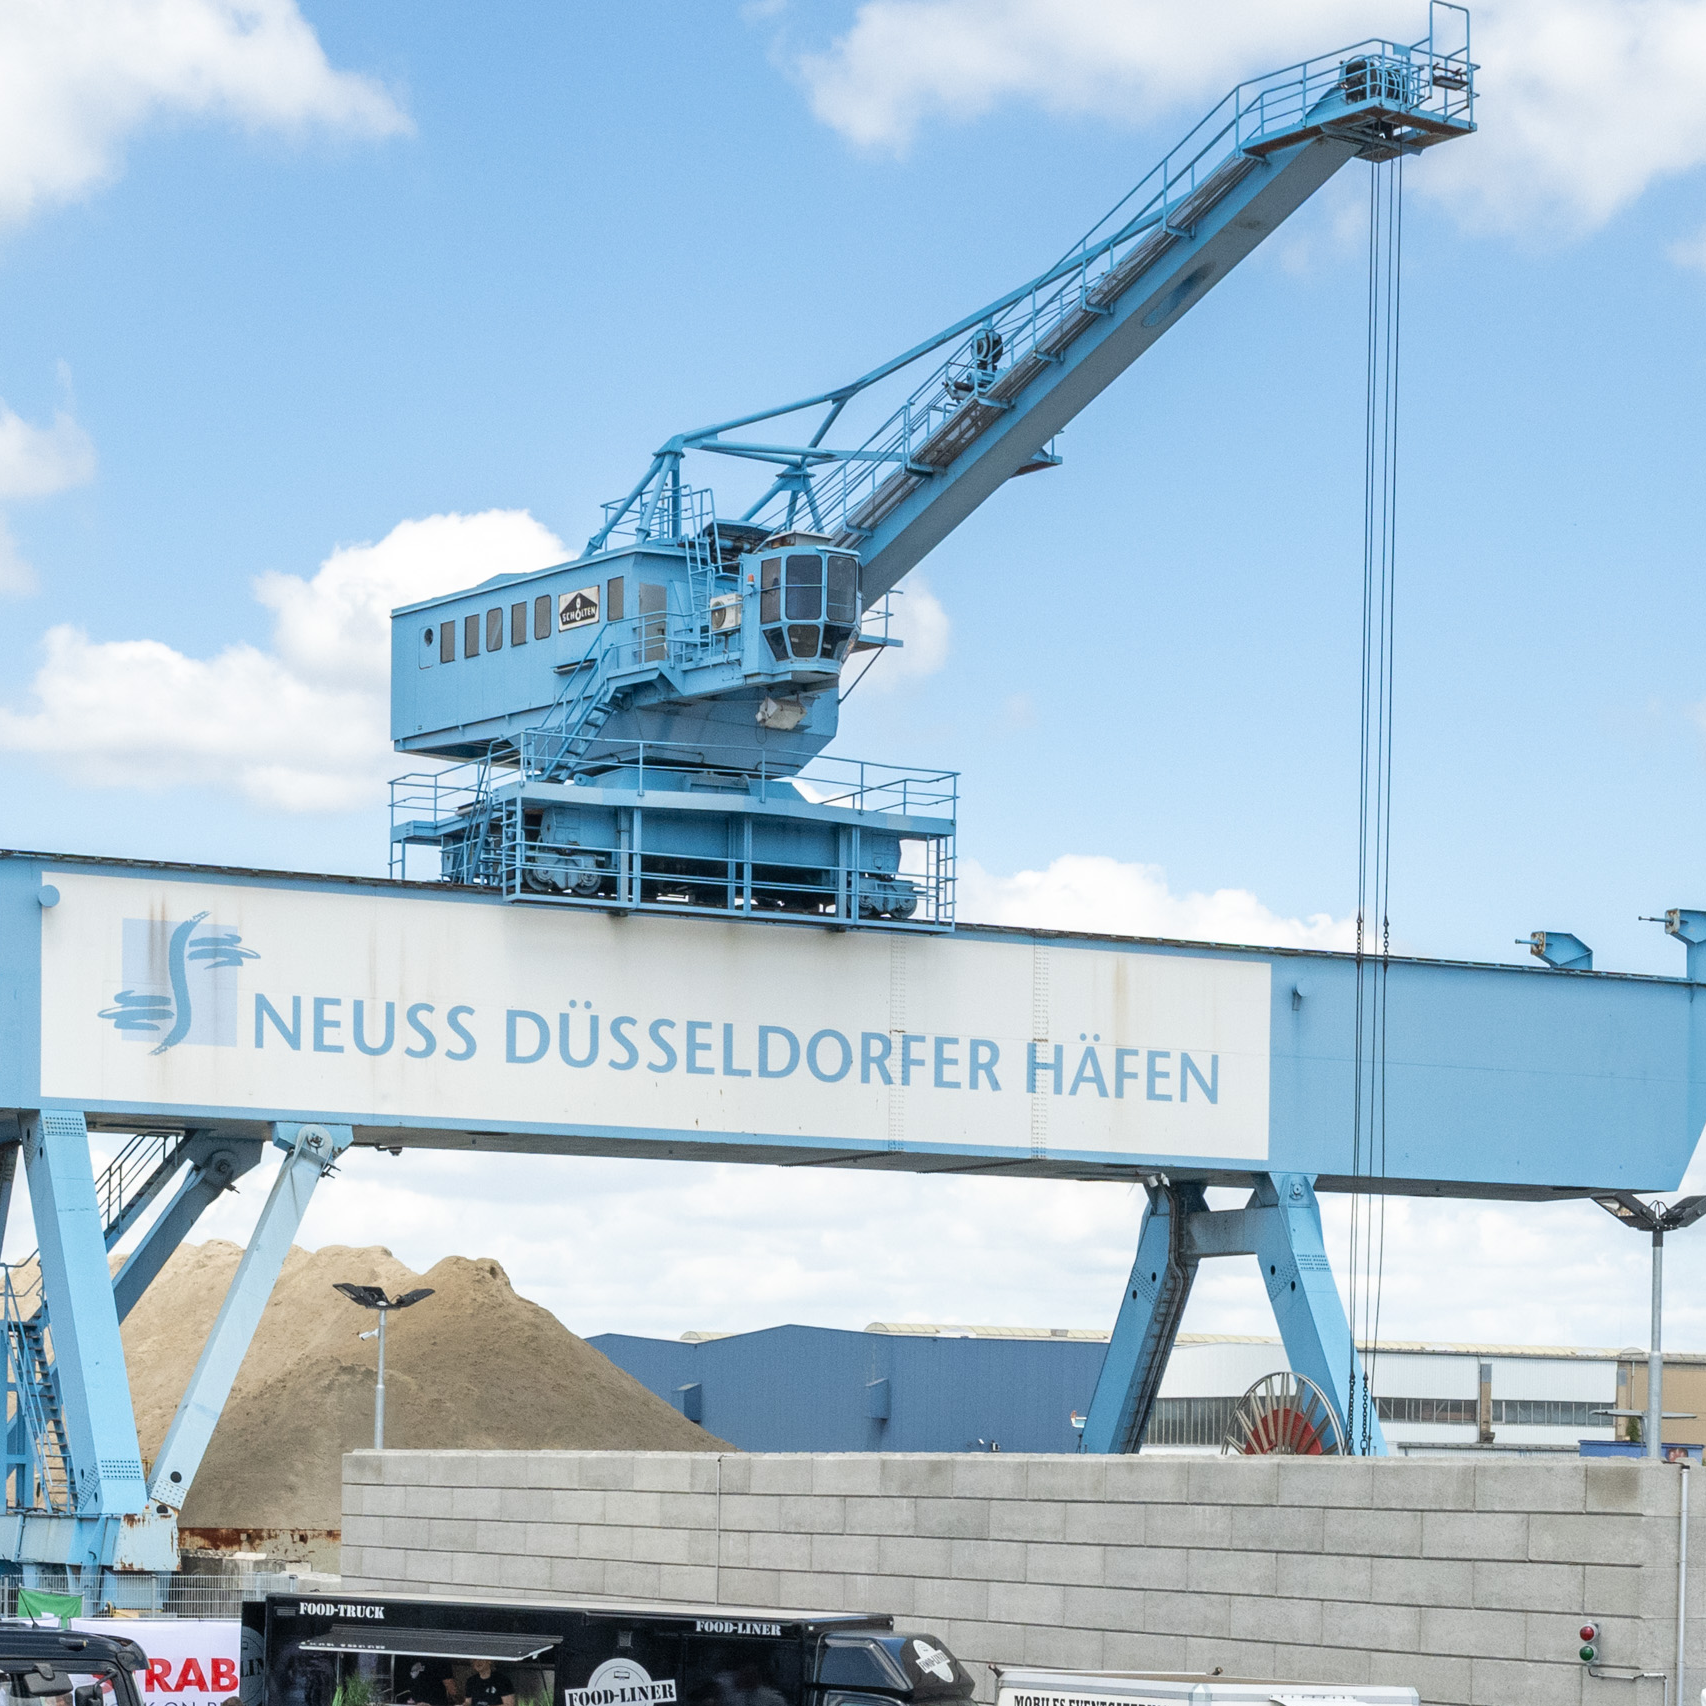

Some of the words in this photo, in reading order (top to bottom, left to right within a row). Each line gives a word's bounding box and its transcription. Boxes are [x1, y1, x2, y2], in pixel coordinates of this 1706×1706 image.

[562, 606, 596, 622] SCHOLTEN
[251, 992, 477, 1062] NEUSS
[505, 1000, 1002, 1093] DÜSSELDORFER
[1028, 1034, 1221, 1106] HÄFEN
[299, 1602, 385, 1619] FOOD-TRUCK
[696, 1620, 781, 1636] FOOD-LINER
[568, 1683, 675, 1706] FOOD-LINER
